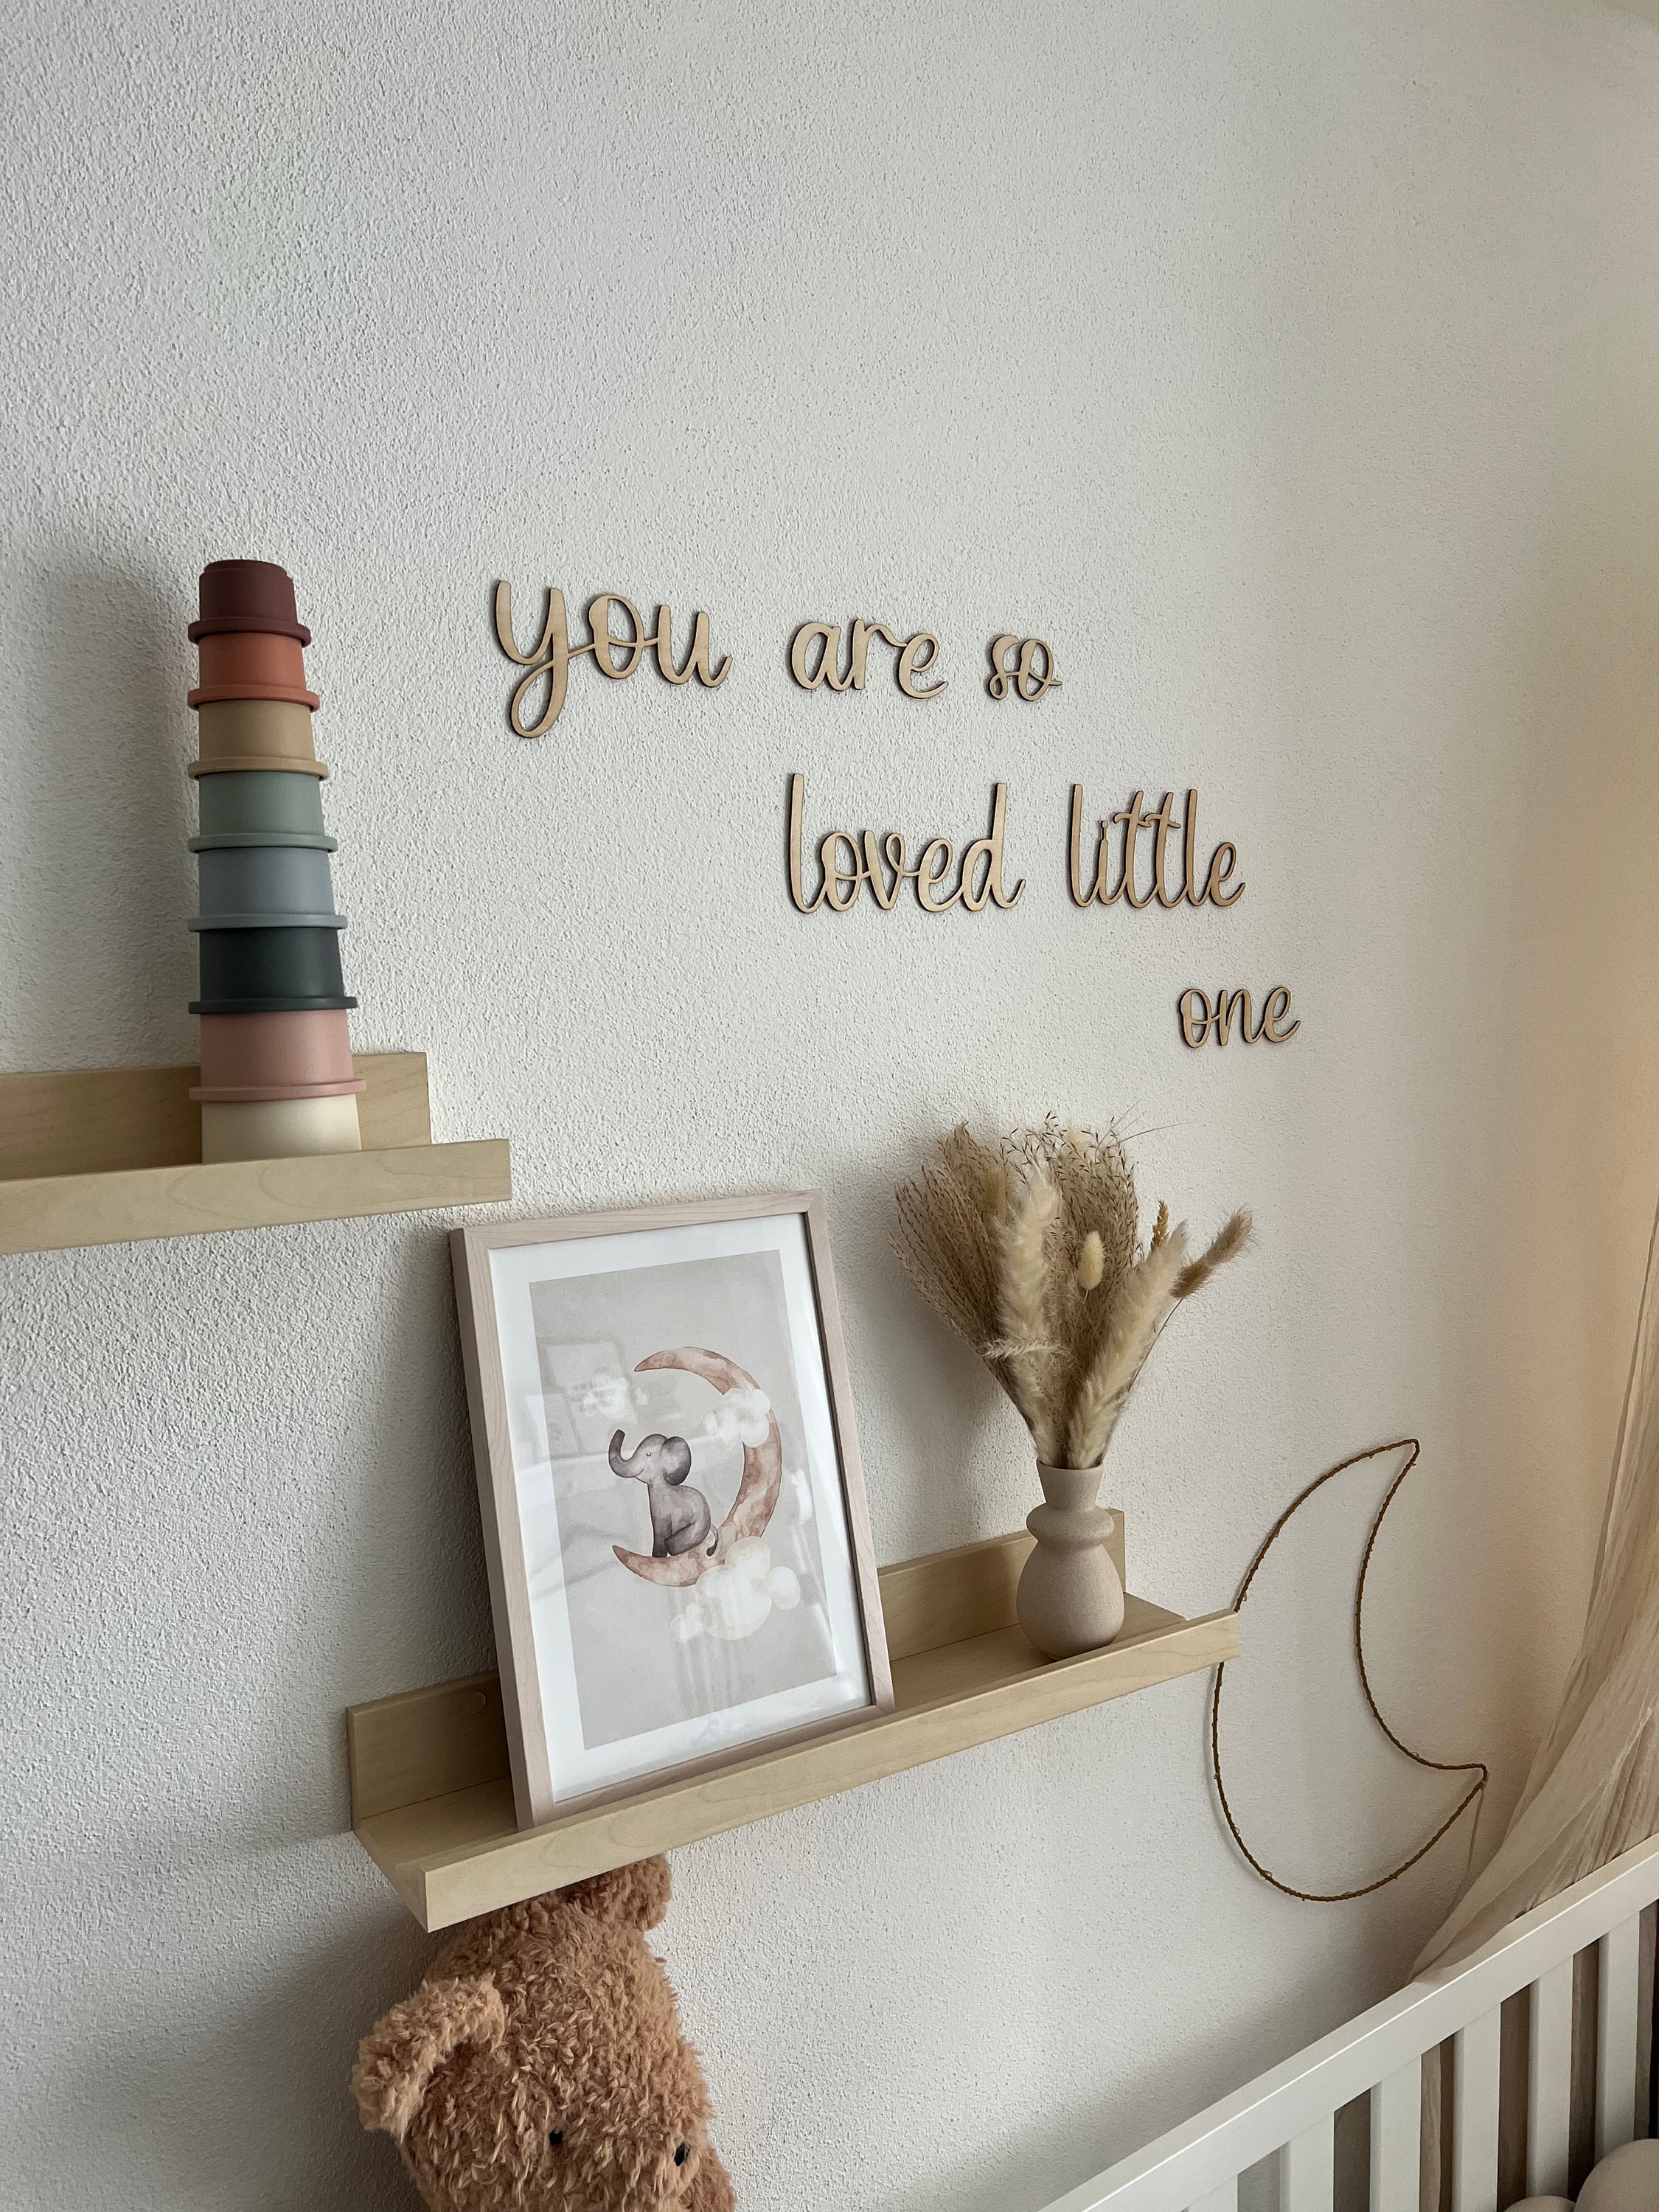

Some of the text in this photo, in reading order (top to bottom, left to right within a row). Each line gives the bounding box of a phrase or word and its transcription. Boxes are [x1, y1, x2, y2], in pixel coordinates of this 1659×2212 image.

[493, 580, 1062, 738] you are so
[787, 773, 1246, 914] loved little
[1179, 986, 1301, 1048] one
